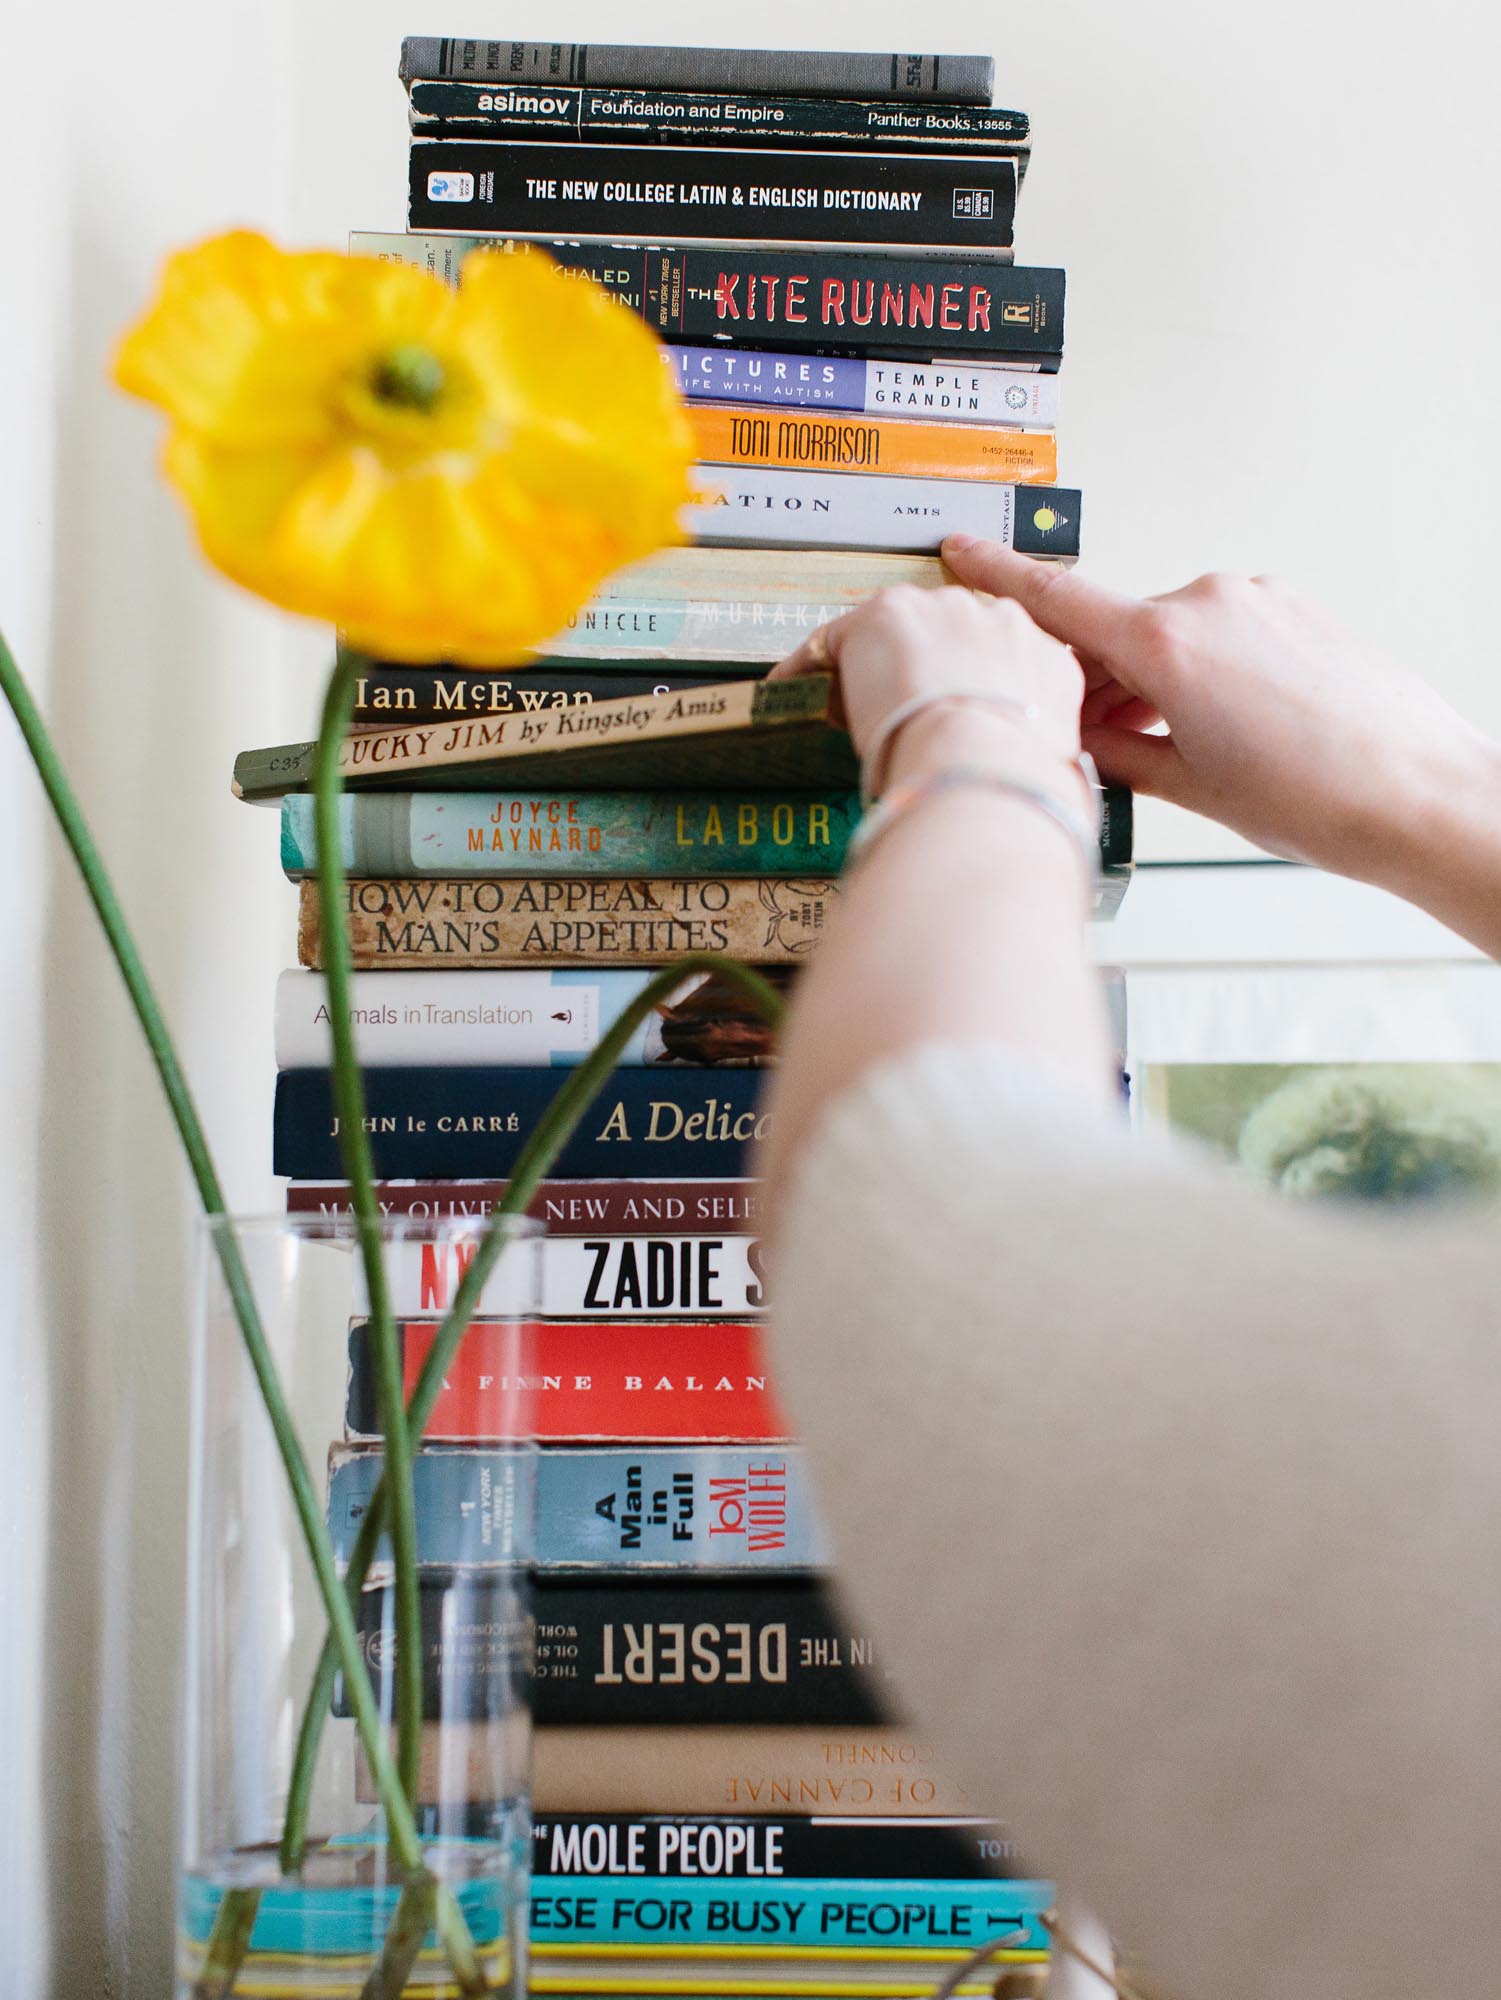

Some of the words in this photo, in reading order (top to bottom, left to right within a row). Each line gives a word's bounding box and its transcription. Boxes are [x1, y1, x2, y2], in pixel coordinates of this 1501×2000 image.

[463, 40, 477, 70] MILTON
[486, 42, 501, 70] MINOR
[510, 43, 524, 72] POEMS
[477, 92, 570, 115] asimov
[591, 100, 685, 118] Foundation
[688, 106, 720, 119] and
[724, 105, 784, 122] Empire
[868, 112, 922, 128] Panther
[925, 115, 971, 130] Books
[978, 120, 1012, 131] 13555
[486, 171, 494, 203] LANGUAGE
[526, 179, 557, 199] THE
[563, 181, 599, 201] NEW
[603, 182, 675, 204] COLLEGE
[680, 185, 727, 205] LATIN
[731, 186, 744, 206] &
[749, 187, 818, 209] ENGLISH
[823, 190, 922, 211] DICTIONARY
[551, 265, 630, 284] KHALED
[662, 258, 670, 287] TIMES
[649, 290, 659, 301] #1
[661, 288, 669, 307] YORK
[671, 268, 681, 318] BESTSELLER
[687, 288, 724, 301] THE
[716, 272, 809, 324] KITE
[821, 278, 991, 332] RUNNER
[659, 308, 668, 326] NEW
[675, 378, 711, 389] LIFE
[723, 382, 762, 393] WITH
[774, 386, 834, 399] AUTISM
[876, 371, 979, 391] TEMPLE
[875, 391, 979, 410] GRANDIN
[1031, 384, 1040, 415] VINTAGE
[729, 418, 770, 457] TONI
[778, 422, 880, 465] MORRISON
[1005, 457, 1034, 466] FICTION
[893, 506, 941, 517] AMIS
[1002, 491, 1010, 544] VINTAGE
[355, 679, 416, 709] Ian
[444, 721, 508, 752] JIM
[520, 720, 548, 744] by
[557, 704, 654, 739] Kingsley
[665, 693, 727, 721] Amis
[490, 801, 579, 824] JOYCE
[676, 803, 830, 846] LABOR
[467, 827, 602, 852] MAYNARD
[446, 883, 504, 913] TO
[511, 881, 664, 913] APPEAL
[673, 881, 731, 912] TO
[789, 909, 798, 922] BY
[800, 902, 811, 927] TOBY
[814, 901, 824, 928] STEIN
[376, 921, 500, 953] MAN'S
[520, 920, 729, 953] APPETITES
[404, 1005, 422, 1024] in
[423, 1004, 533, 1024] Translation
[330, 1117, 396, 1136] JHN
[408, 1116, 426, 1132] le
[437, 1112, 520, 1132] CARRÉ
[595, 1101, 632, 1141] A
[319, 1202, 394, 1218] MAY
[408, 1200, 502, 1219] OLIVE
[546, 1199, 609, 1220] NEW
[624, 1198, 685, 1220] AND
[696, 1198, 756, 1219] SELE
[584, 1241, 723, 1308] ZADIE
[624, 1376, 767, 1391] BALAN
[480, 1467, 491, 1510] YORK
[595, 1493, 616, 1522] A
[620, 1466, 641, 1548] Man
[647, 1490, 667, 1524] in
[673, 1473, 693, 1541] Full
[709, 1478, 746, 1538] TOM
[748, 1463, 786, 1552] WOLFE
[481, 1511, 492, 1545] NEW
[537, 1624, 578, 1638] WORL
[557, 1645, 578, 1658] OIL
[595, 1623, 787, 1683] DESERT
[800, 1638, 842, 1666] THE
[851, 1638, 872, 1664] IN
[550, 1665, 578, 1678] THE
[724, 1777, 874, 1804] CANNAE
[889, 1777, 936, 1803] OF
[529, 1826, 548, 1840] HE
[550, 1824, 646, 1874] MOLE
[659, 1825, 784, 1875] PEOPLE
[613, 1898, 692, 1931] FOR
[707, 1900, 806, 1933] BUSY
[820, 1903, 972, 1936] PEOPLE
